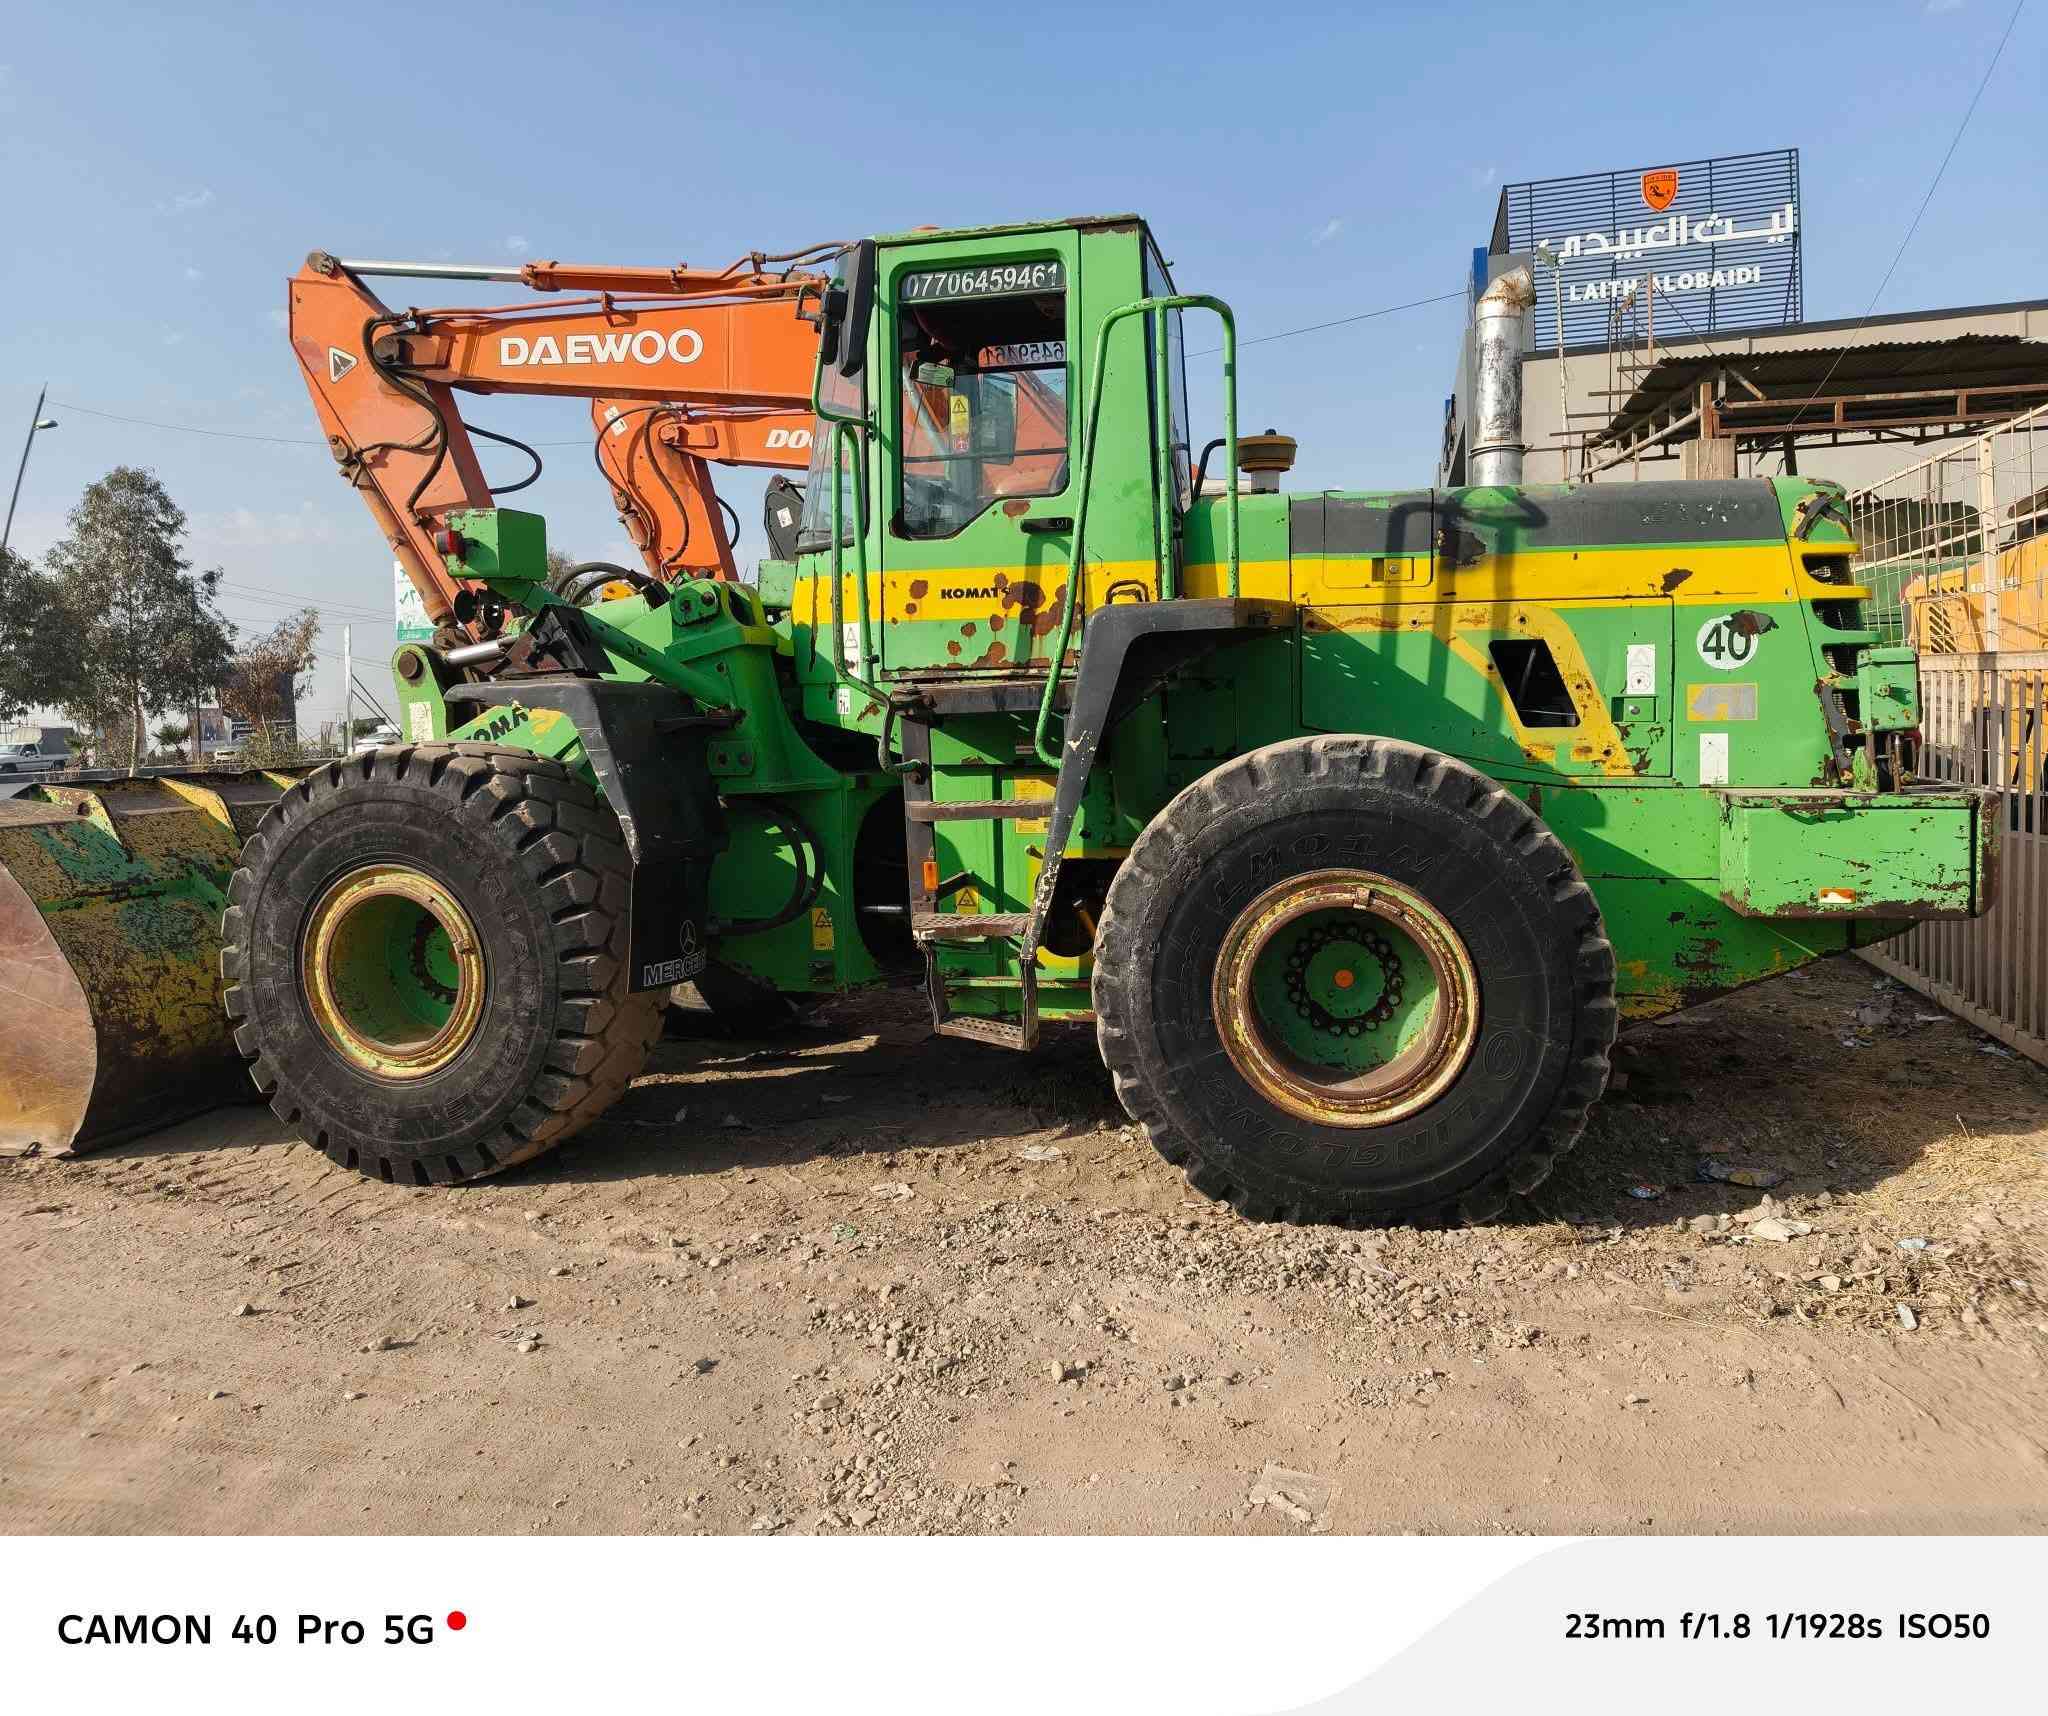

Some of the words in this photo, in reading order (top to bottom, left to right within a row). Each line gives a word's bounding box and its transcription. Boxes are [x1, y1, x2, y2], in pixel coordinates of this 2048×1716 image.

[1693, 203, 1793, 244] ليث
[907, 264, 1057, 297] 07706459461
[1569, 279, 1638, 301] LAITH
[1651, 266, 1761, 292] ALOBAIDI
[500, 328, 704, 366] DAEWOO
[765, 429, 815, 448] DO
[1702, 622, 1752, 660] 40
[464, 704, 529, 741] OMA
